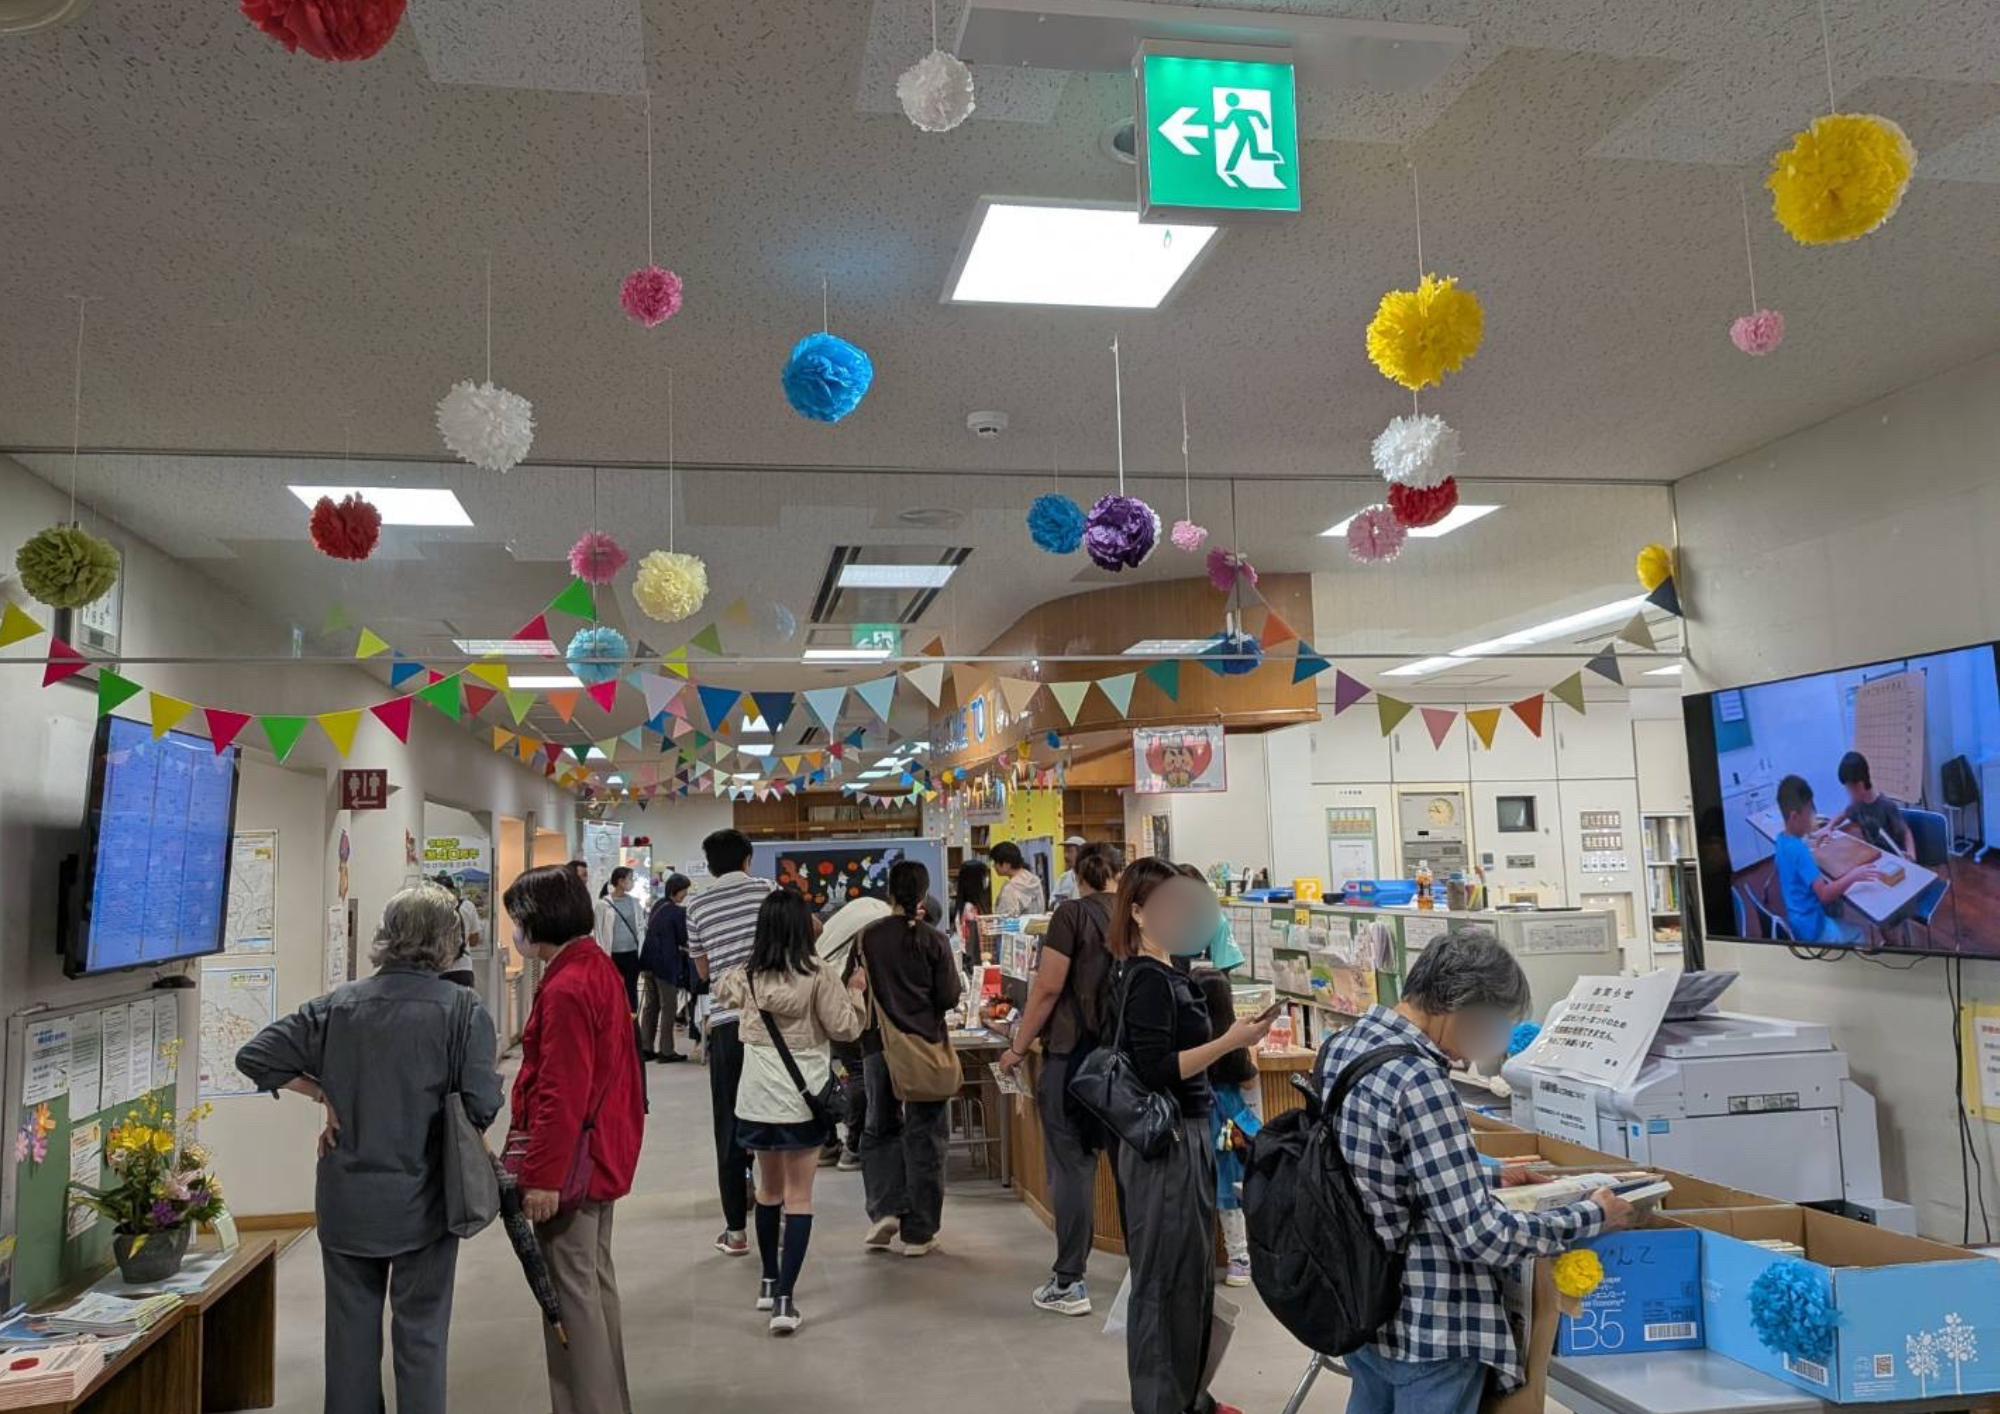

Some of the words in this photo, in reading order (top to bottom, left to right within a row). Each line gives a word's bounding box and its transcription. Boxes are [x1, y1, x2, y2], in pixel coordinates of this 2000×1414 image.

[1592, 986, 1634, 999] お知らせ
[1570, 1309, 1625, 1351] B5
